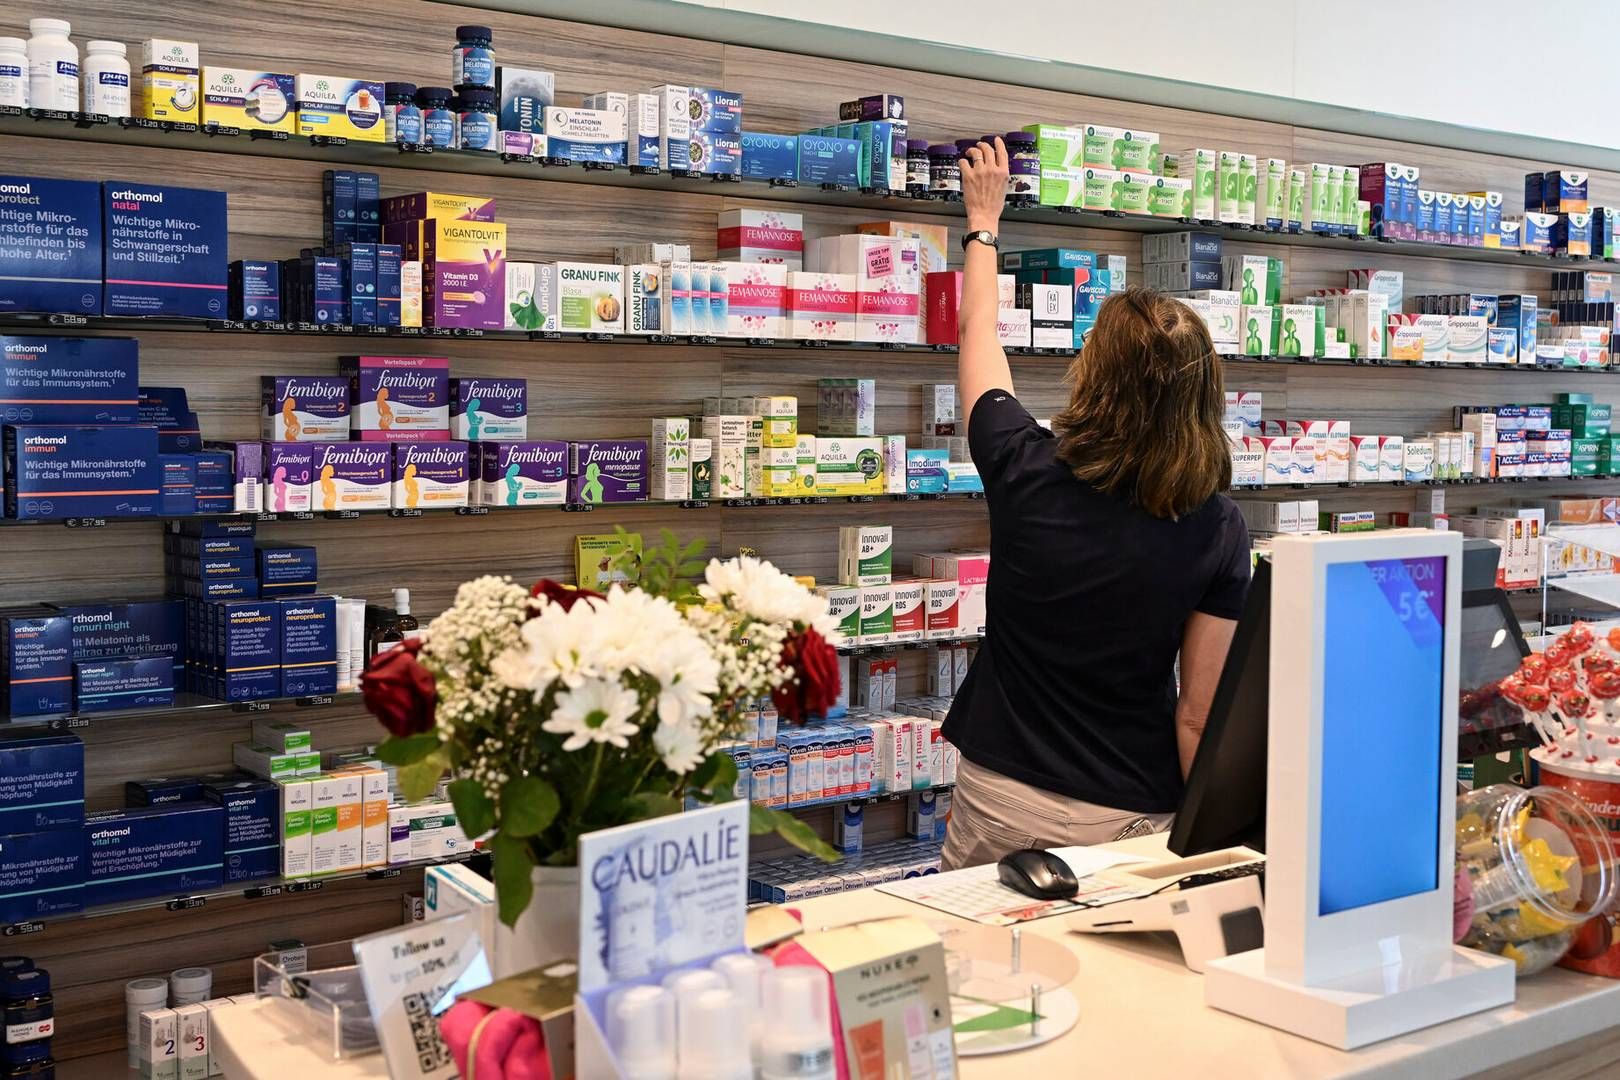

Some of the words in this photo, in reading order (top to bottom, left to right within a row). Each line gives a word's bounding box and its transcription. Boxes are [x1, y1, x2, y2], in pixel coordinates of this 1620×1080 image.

[102, 73, 127, 82] pure
[210, 85, 243, 94] AQUILEA
[305, 90, 336, 100] AQUILEA
[569, 118, 602, 126] MELATONIN
[561, 130, 609, 139] SCHMELZTABLETTEN
[715, 138, 739, 149] Lioran
[742, 136, 779, 149] OYONO
[803, 138, 842, 153] OYONO
[112, 190, 164, 203] orthomol
[112, 200, 141, 211] natal
[433, 199, 467, 207] VIGANTOLVIT
[1, 210, 33, 222] htige
[112, 214, 163, 229] Wichtige
[164, 218, 201, 231] Mikro-
[46, 224, 62, 236] für
[66, 225, 89, 237] das
[112, 227, 170, 241] nährstoffe
[172, 230, 183, 241] in
[443, 227, 501, 241] VIGANTOLVIT
[746, 229, 795, 242] FEMANNOSE
[68, 237, 86, 249] bis
[112, 239, 210, 256] Schwangerschaft
[0, 247, 32, 259] hohe
[112, 251, 135, 262] und
[870, 258, 890, 267] GRATIS
[443, 272, 468, 281] Vitamin
[469, 273, 479, 281] D3
[561, 268, 596, 282] GRANU
[597, 270, 620, 283] FINK
[443, 279, 458, 287] 2000
[632, 270, 641, 296] FINK
[541, 266, 551, 314] Gingium
[1079, 285, 1107, 295] GAVISCON
[799, 293, 848, 305] FEMANNOSE
[862, 296, 909, 306] FEMANNOSE
[1049, 292, 1057, 302] KA
[1211, 295, 1240, 306] Bianacid
[1049, 302, 1057, 312] EX
[632, 297, 641, 331] GRANU
[1447, 319, 1479, 329] Grippostad
[5, 343, 48, 354] orthomol
[5, 353, 37, 361] immun
[5, 367, 48, 379] Wichtige
[51, 368, 126, 379] Mikronährstoffe
[5, 378, 20, 388] für
[22, 378, 40, 388] das
[371, 369, 437, 391] femibion
[277, 378, 346, 402] femibion
[462, 380, 522, 402] femibion
[1498, 408, 1512, 416] ACC
[24, 435, 67, 446] orthomol
[24, 445, 57, 453] immun
[1578, 443, 1600, 453] ASPIRIN
[315, 444, 387, 469] femibion
[399, 443, 465, 469] femibion
[500, 445, 563, 468] femibion
[582, 443, 641, 466] femibion
[820, 453, 847, 462] AQUILEA
[1232, 454, 1262, 462] SUPERPEP
[25, 459, 69, 471] Wichtige
[71, 459, 147, 470] Mikronährstoffe
[604, 463, 640, 473] menopause
[908, 457, 941, 469] Imodium
[25, 470, 40, 480] für
[42, 470, 60, 479] das
[456, 467, 463, 479] 1
[861, 533, 889, 544] Innovall
[205, 540, 230, 549] orthomol
[861, 545, 874, 553] AB+
[267, 552, 292, 560] orthomol
[205, 561, 231, 570] orthomol
[208, 582, 233, 591] orthomol
[930, 600, 942, 608] RDS
[73, 611, 113, 624] rthomol
[230, 609, 260, 619] orthomol
[286, 607, 314, 617] orthomol
[286, 613, 326, 622] neuroprotect
[230, 615, 272, 624] neuroprotect
[14, 624, 47, 634] orthomol
[105, 621, 130, 632] night
[85, 634, 134, 646] Melatonin
[136, 633, 151, 642] als
[123, 641, 178, 655] Verkürzung
[855, 736, 871, 745] Olynth
[0, 772, 65, 783] Mikronährstoffe
[66, 770, 79, 778] zur
[17, 783, 33, 791] von
[34, 778, 74, 790] Müdigkeit
[152, 793, 182, 804] orthomol
[227, 797, 256, 807] orthomol
[91, 826, 131, 839] orthomol
[91, 838, 110, 847] vital
[111, 837, 121, 845] m
[91, 849, 127, 861] Wichtige
[127, 841, 190, 855] Mikronährstoffe
[190, 839, 203, 848] zur
[91, 856, 142, 869] Verringerung
[143, 853, 159, 861] von
[159, 847, 198, 860] Müdigkeit
[2, 857, 65, 871] Mikronährstoffe
[18, 869, 34, 877] von
[35, 863, 75, 875] Müdigkeit
[91, 867, 107, 876] und
[391, 940, 430, 960] Follow
[860, 960, 906, 979] NUXE
[164, 1038, 175, 1055] 2
[194, 1035, 205, 1051] 3
